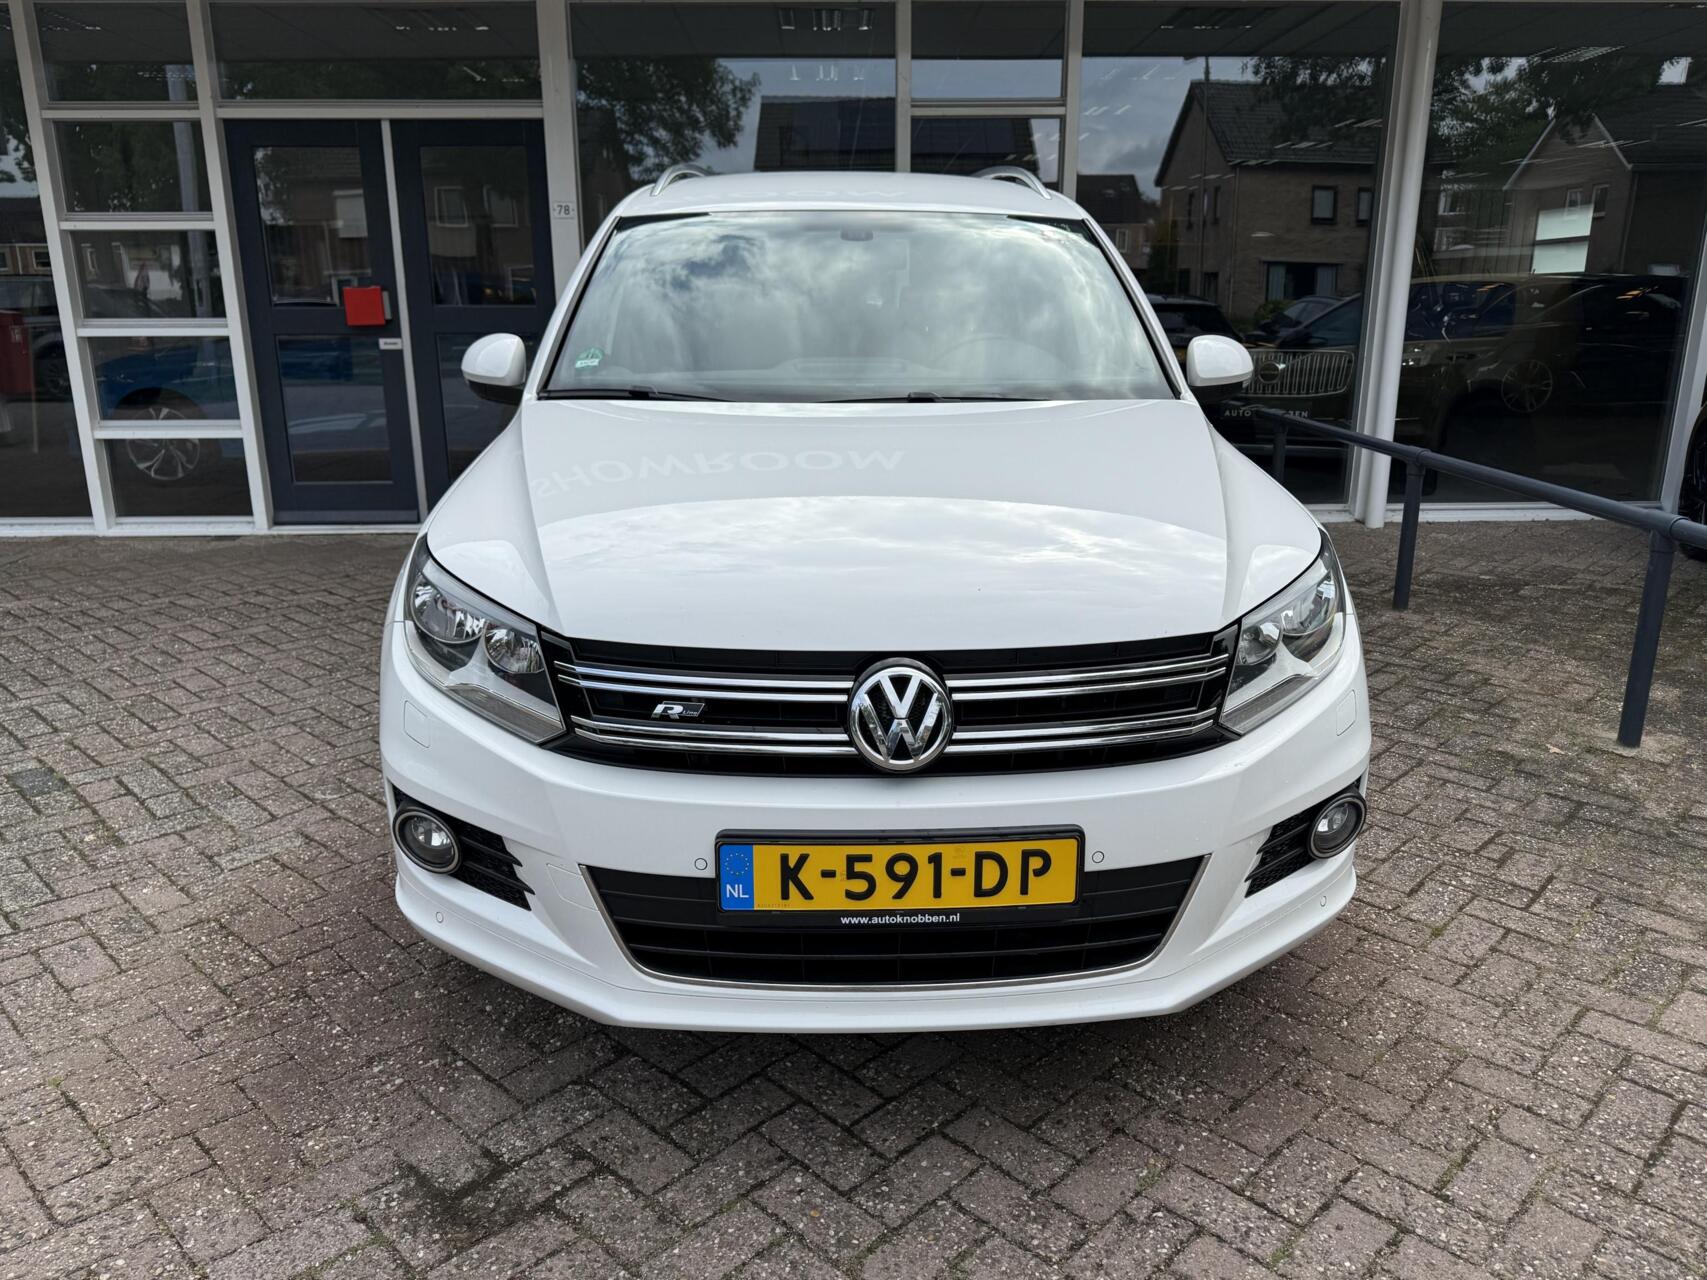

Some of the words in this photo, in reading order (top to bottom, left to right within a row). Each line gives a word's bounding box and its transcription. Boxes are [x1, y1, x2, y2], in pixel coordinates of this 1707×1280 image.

[779, 848, 1052, 901] K-591-DP
[726, 884, 749, 898] NL
[840, 913, 960, 924] www.autoknobben.nl
